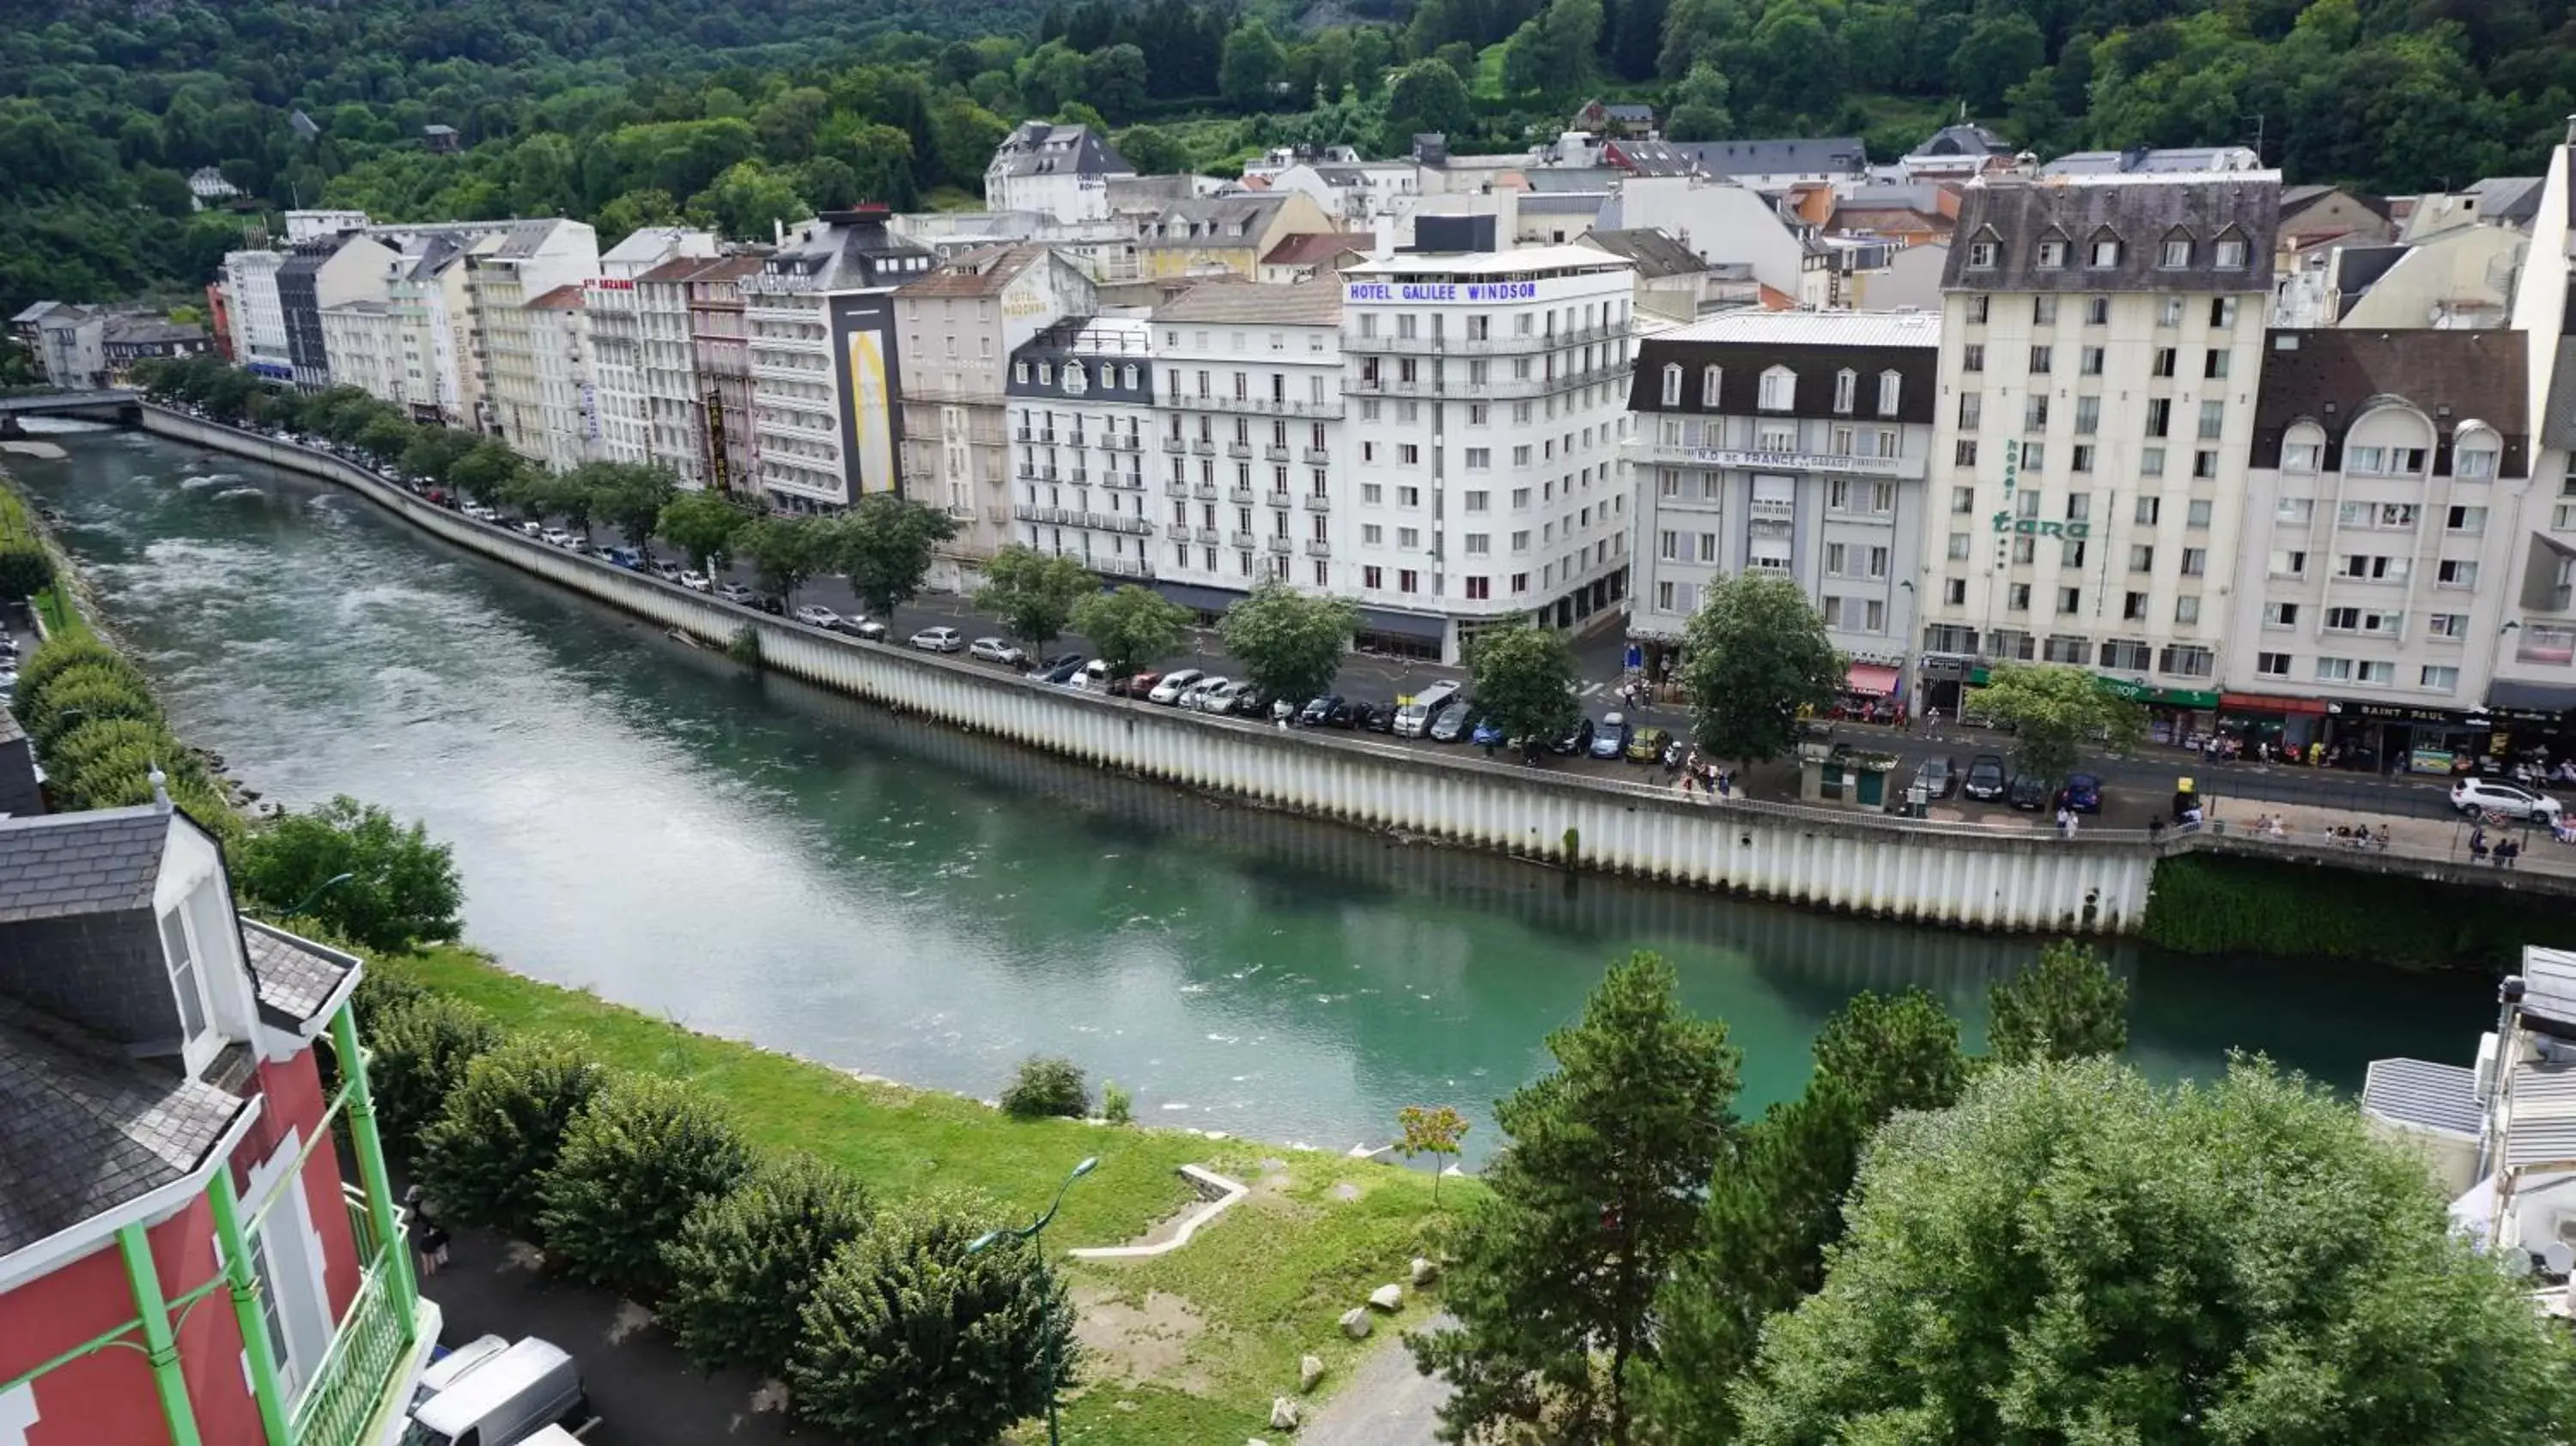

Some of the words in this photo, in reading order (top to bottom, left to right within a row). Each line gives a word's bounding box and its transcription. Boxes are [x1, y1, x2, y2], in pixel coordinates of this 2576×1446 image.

[1351, 284, 1392, 299] HOTEL
[1402, 284, 1456, 300] GALILEE
[1467, 283, 1536, 300] WINDSOR
[1744, 453, 1796, 465] FRANCE
[2362, 705, 2403, 718] SAINT
[2410, 710, 2445, 721] PAUL
